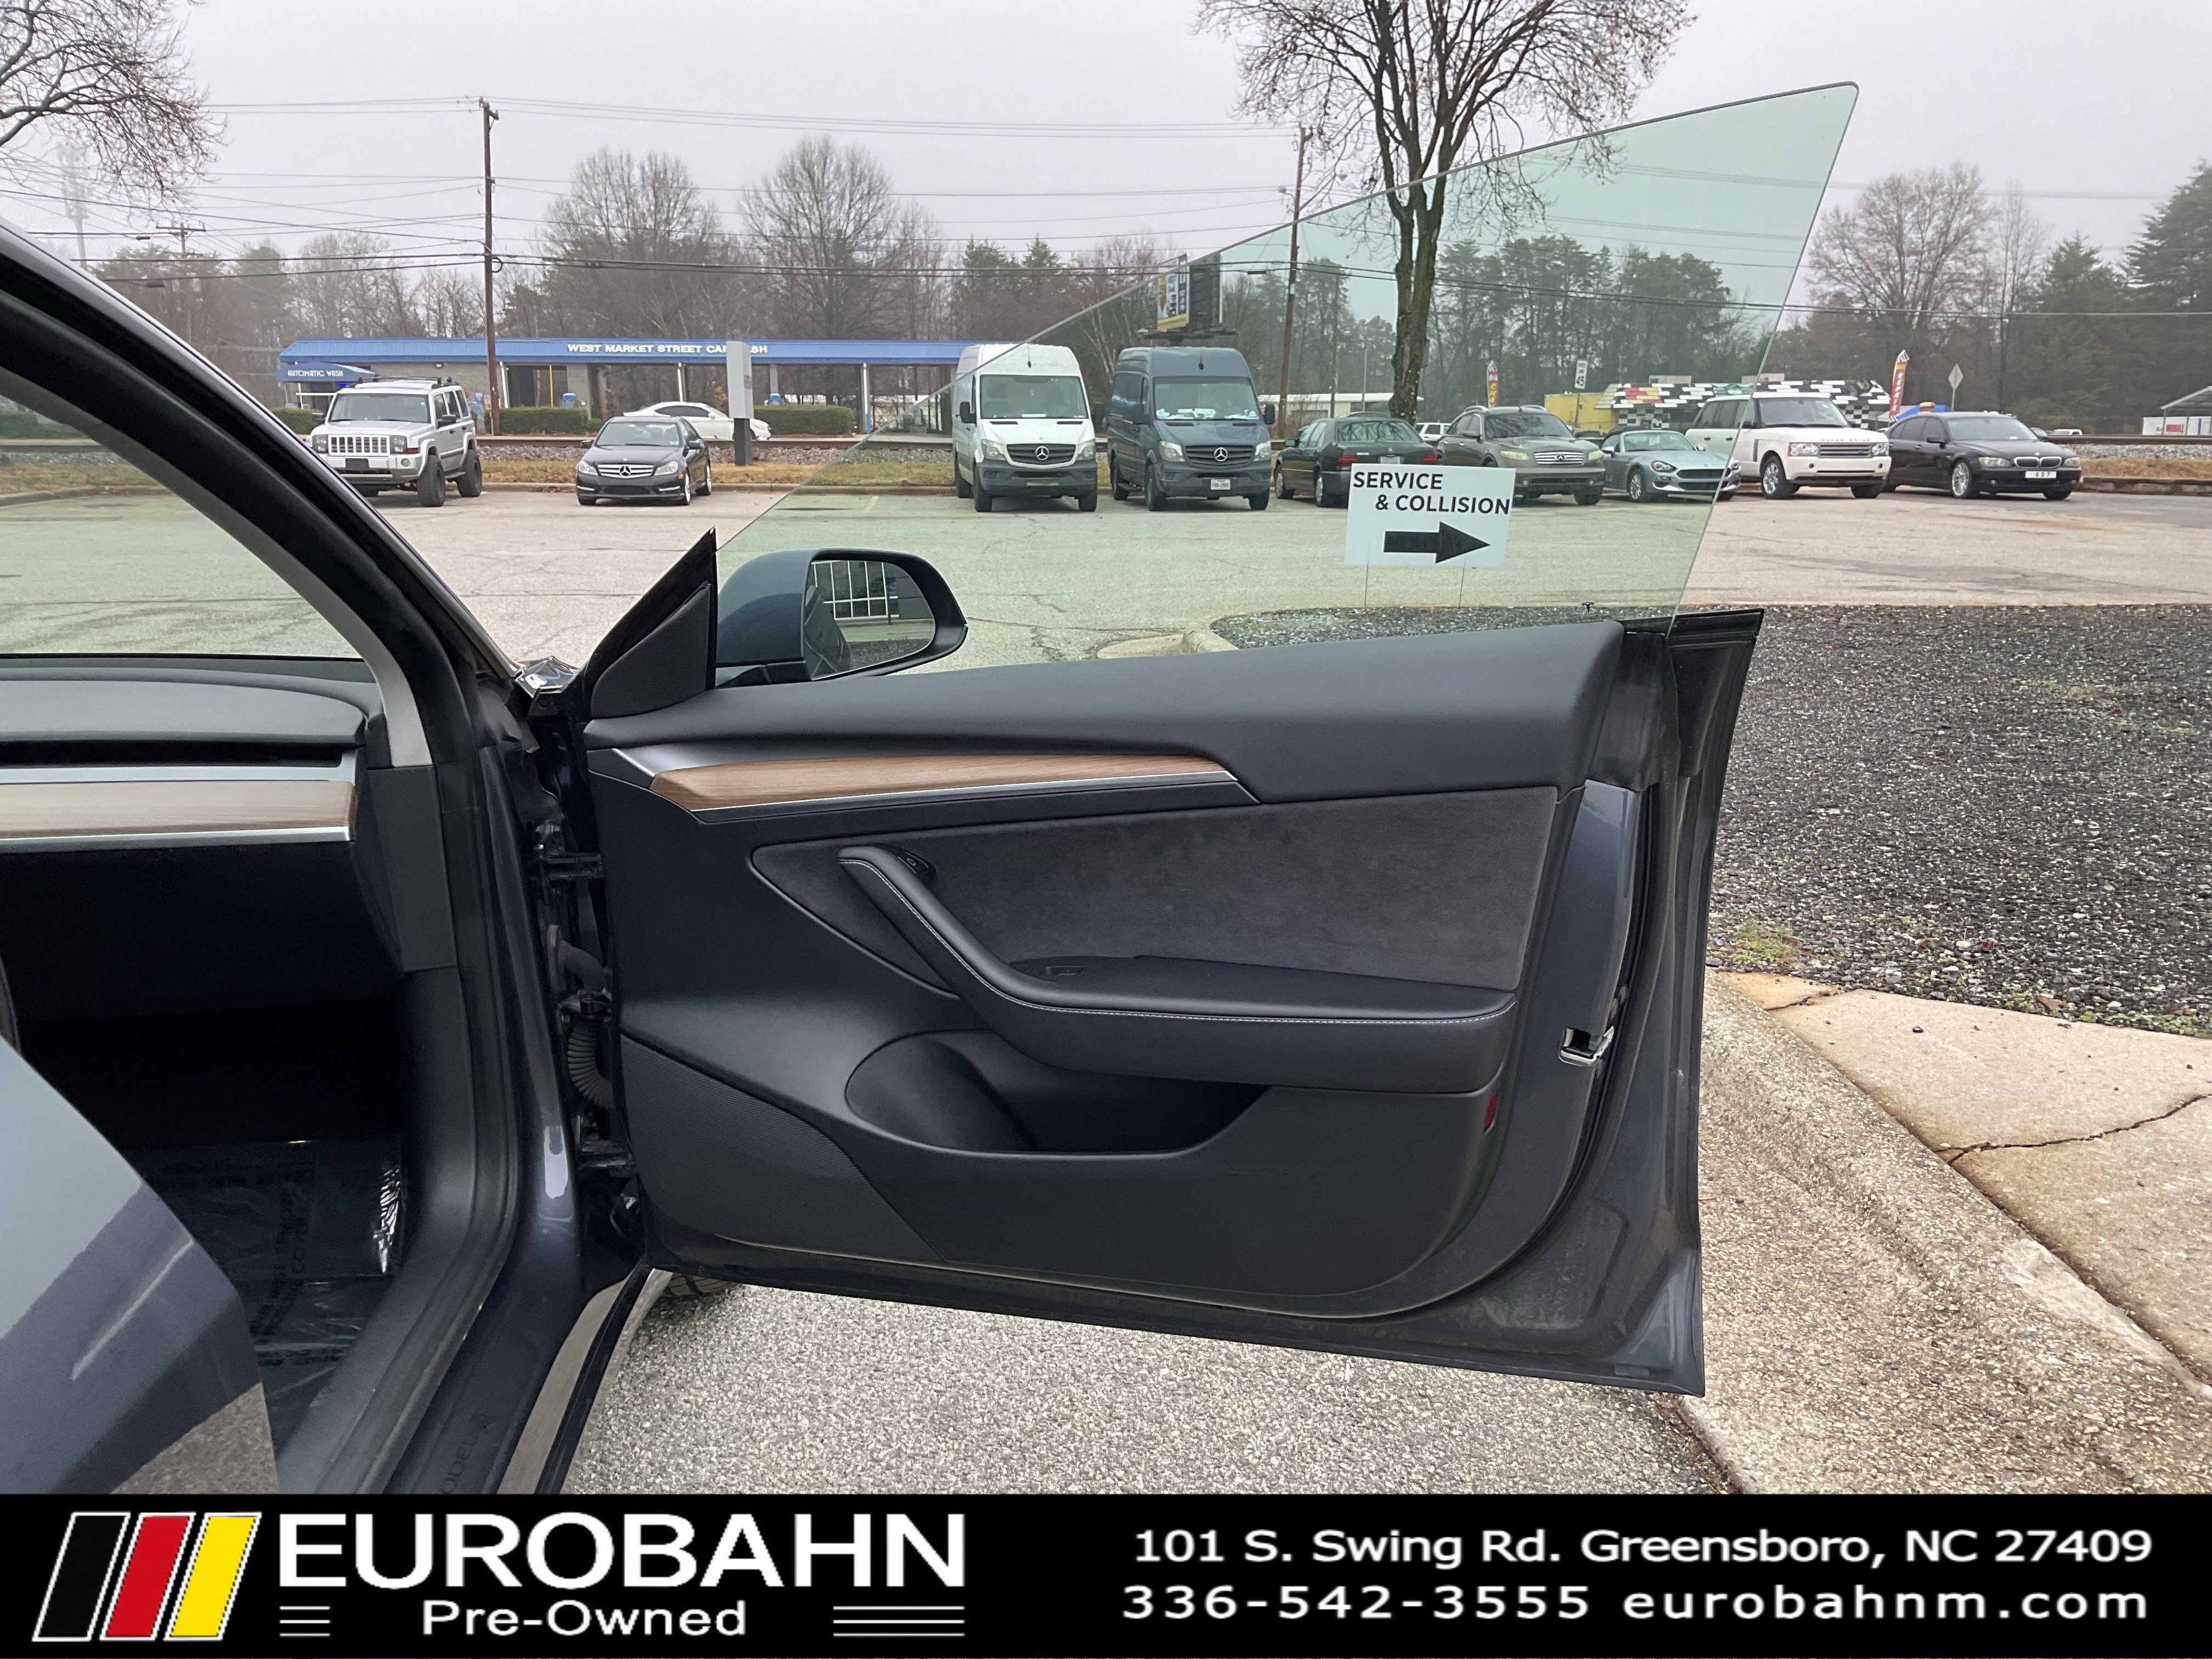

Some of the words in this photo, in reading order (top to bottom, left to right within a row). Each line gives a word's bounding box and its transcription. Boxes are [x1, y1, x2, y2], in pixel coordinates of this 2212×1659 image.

[567, 344, 602, 353] WEST
[605, 344, 654, 353] MARKET
[658, 345, 702, 353] STREET
[749, 345, 768, 353] SH
[1576, 375, 1585, 387] 45
[1353, 471, 1443, 489] SERVICE
[1375, 494, 1389, 510] &
[1395, 494, 1510, 515] COLLISION
